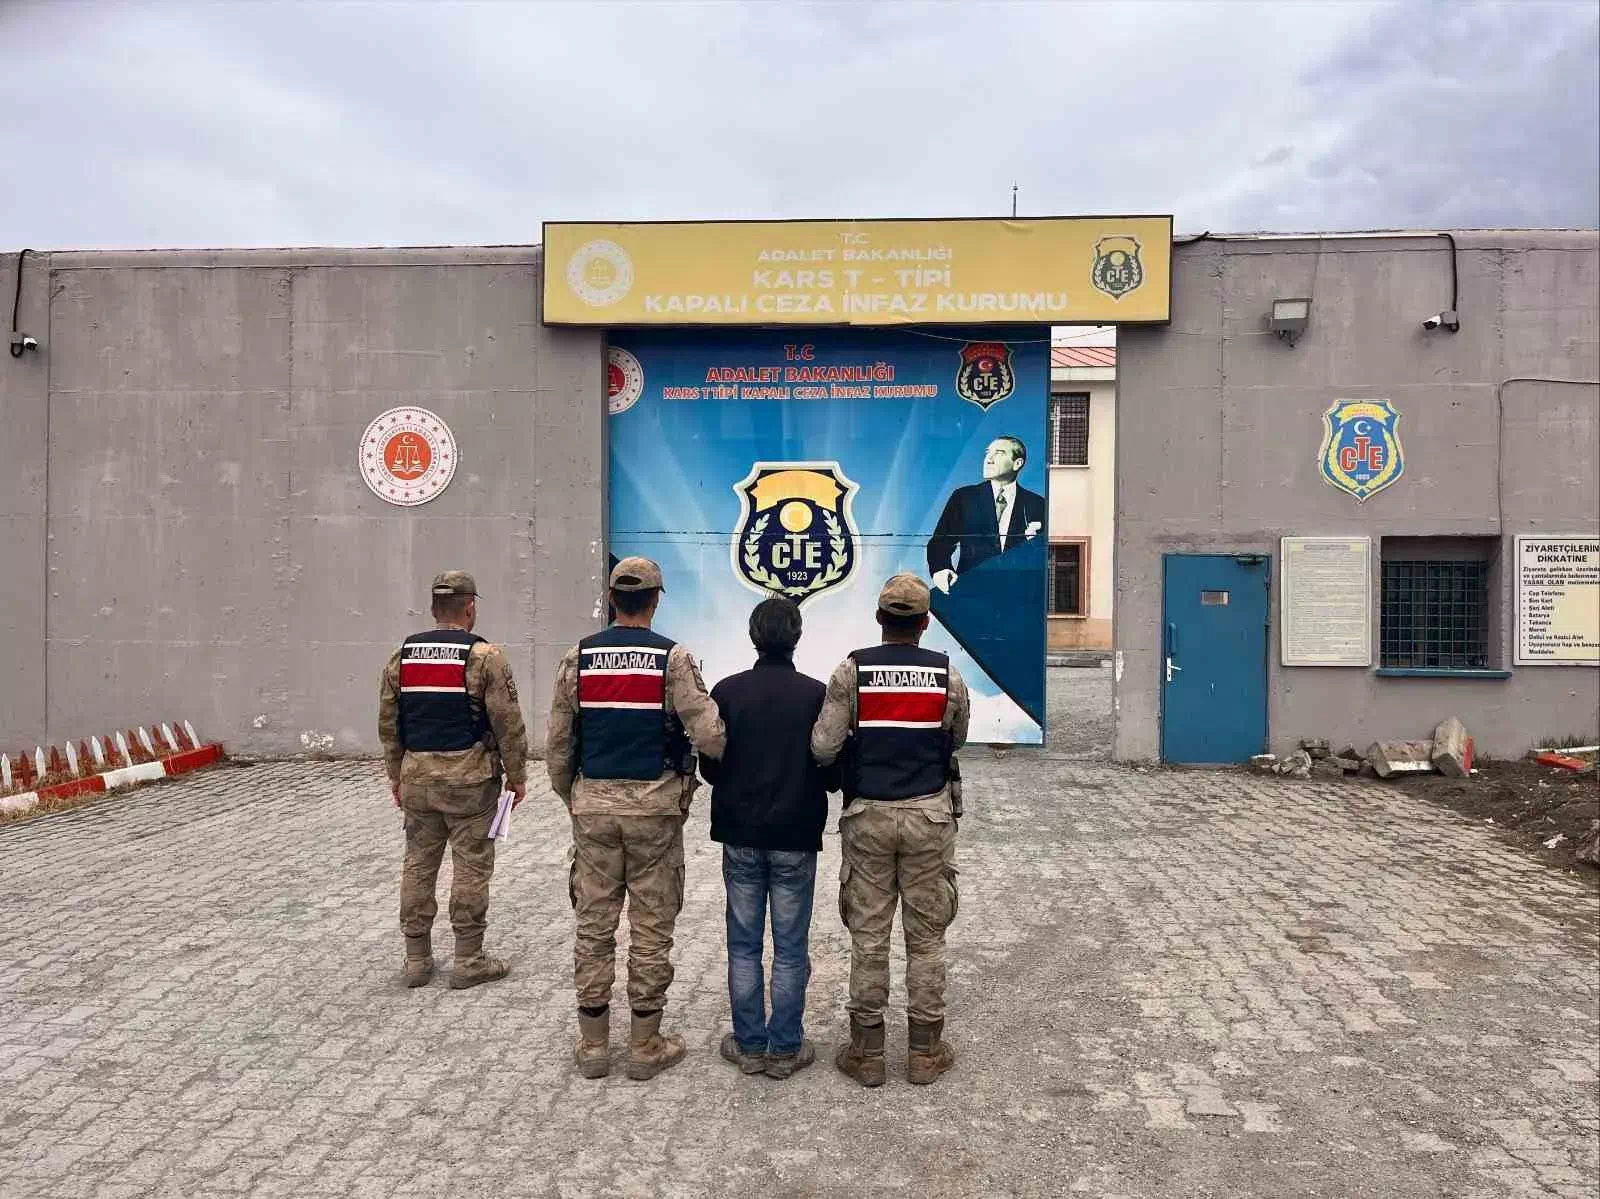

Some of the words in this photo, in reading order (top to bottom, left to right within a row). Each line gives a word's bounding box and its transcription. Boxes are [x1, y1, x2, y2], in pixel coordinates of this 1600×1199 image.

[757, 248, 836, 262] ADALET
[842, 243, 953, 261] BAKANLIĞI
[752, 269, 834, 289] KARS
[845, 269, 864, 289] T
[895, 263, 951, 289] TİPİ
[644, 294, 748, 313] KAPALI
[756, 294, 835, 313] CEZA
[842, 288, 929, 313] İNFAZ
[935, 291, 1068, 312] KURUMU
[784, 344, 816, 361] T.C
[705, 366, 781, 382] ADALET
[785, 361, 895, 382] BAKANLIĞI
[973, 372, 998, 391] CTE
[663, 386, 699, 400] KARS
[741, 386, 790, 400] KAPALI
[793, 386, 828, 400] CEZA
[831, 383, 871, 400] İNFAZ
[874, 385, 937, 399] KURUMU
[1340, 436, 1384, 472] CTE
[771, 533, 822, 569] CTE
[1525, 543, 1600, 555] ZİYARETÇİLERİN
[1537, 552, 1588, 563] DİKKATİNE
[787, 571, 808, 581] 1923
[408, 647, 460, 660] JANDARMA
[588, 652, 657, 669] JANDARMA
[868, 671, 938, 688] JANDARMA
